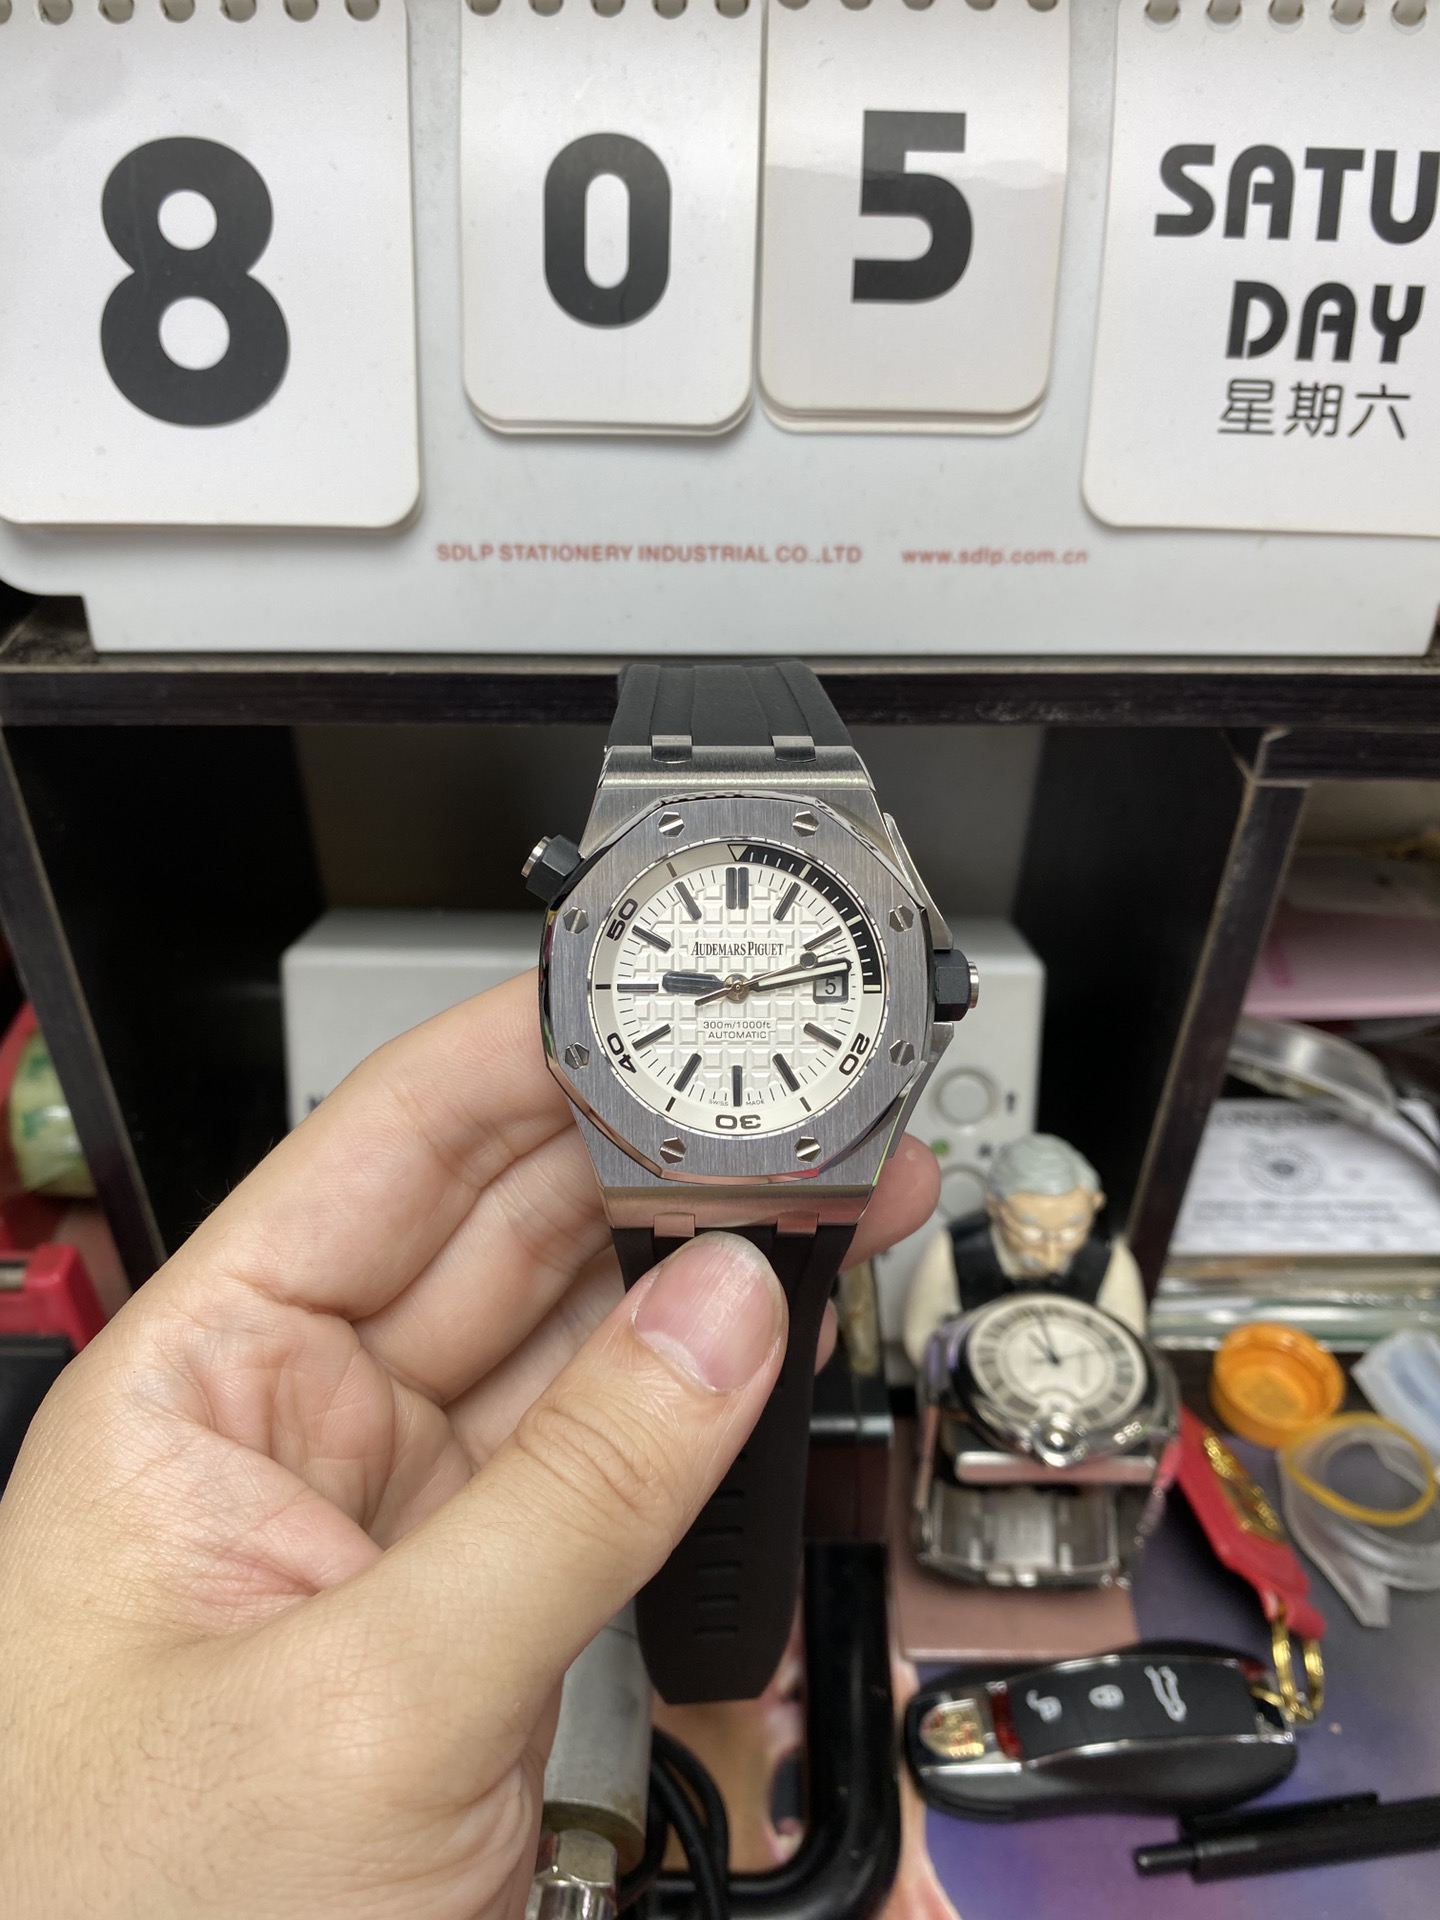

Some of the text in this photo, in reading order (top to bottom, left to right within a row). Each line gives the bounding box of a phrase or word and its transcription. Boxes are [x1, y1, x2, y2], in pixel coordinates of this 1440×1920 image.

[852, 110, 973, 304] 5
[1155, 144, 1440, 245] SATU
[544, 133, 672, 329] 0
[100, 136, 290, 428] 8
[1226, 280, 1425, 364] DAY
[1218, 378, 1411, 439] 星期六
[436, 543, 494, 562] SDLP
[499, 543, 633, 563] STATIONERY
[638, 543, 769, 563] INDUSTRIAL
[901, 546, 1089, 566] www.sdlp.com.cn
[606, 898, 638, 941] 50
[690, 941, 784, 956] AUDEMARS PIGUET
[703, 1021, 771, 1030] 300m/1000ft
[708, 1031, 767, 1039] AUTOMATIC
[607, 1032, 637, 1073] 40
[838, 1032, 870, 1076] 20
[708, 1099, 765, 1107] SWISS MADE
[715, 1114, 761, 1129] 30
